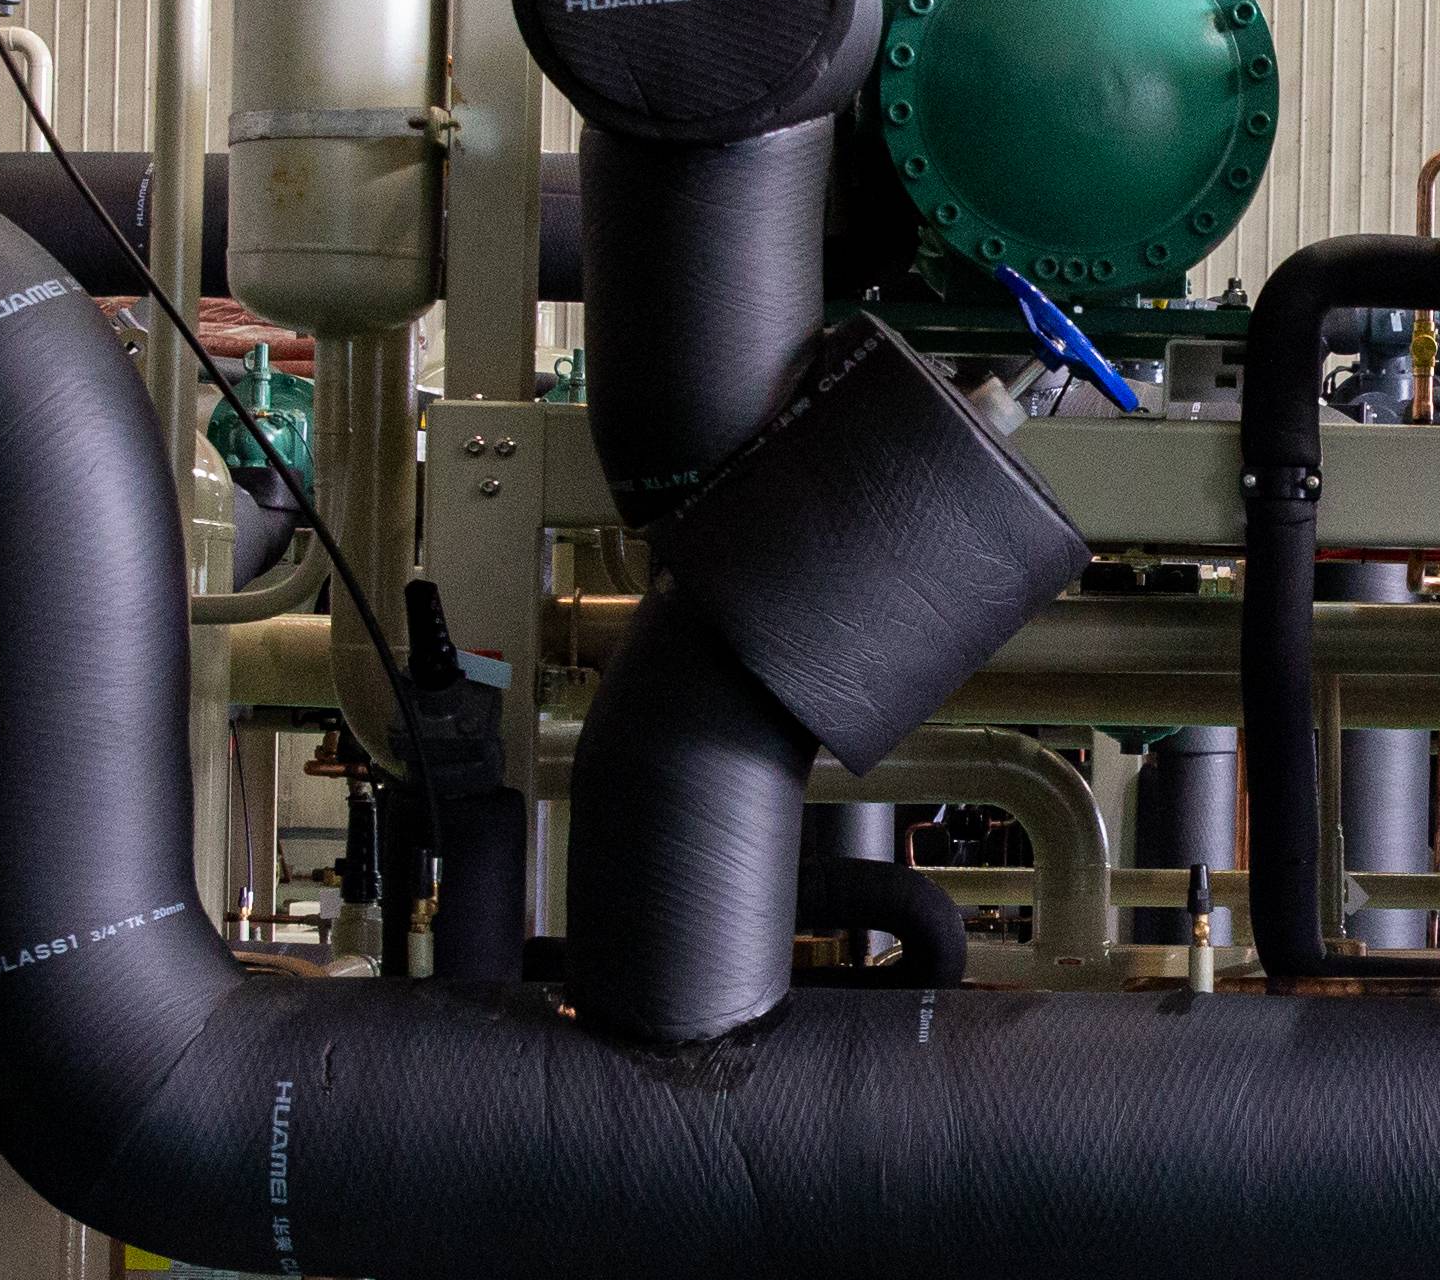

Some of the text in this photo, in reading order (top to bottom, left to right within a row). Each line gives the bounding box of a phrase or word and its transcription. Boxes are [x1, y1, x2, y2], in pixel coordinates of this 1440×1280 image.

[152, 902, 186, 921] 20mm
[919, 1009, 934, 1043] 20mm
[269, 1081, 293, 1205] HUAMEI
